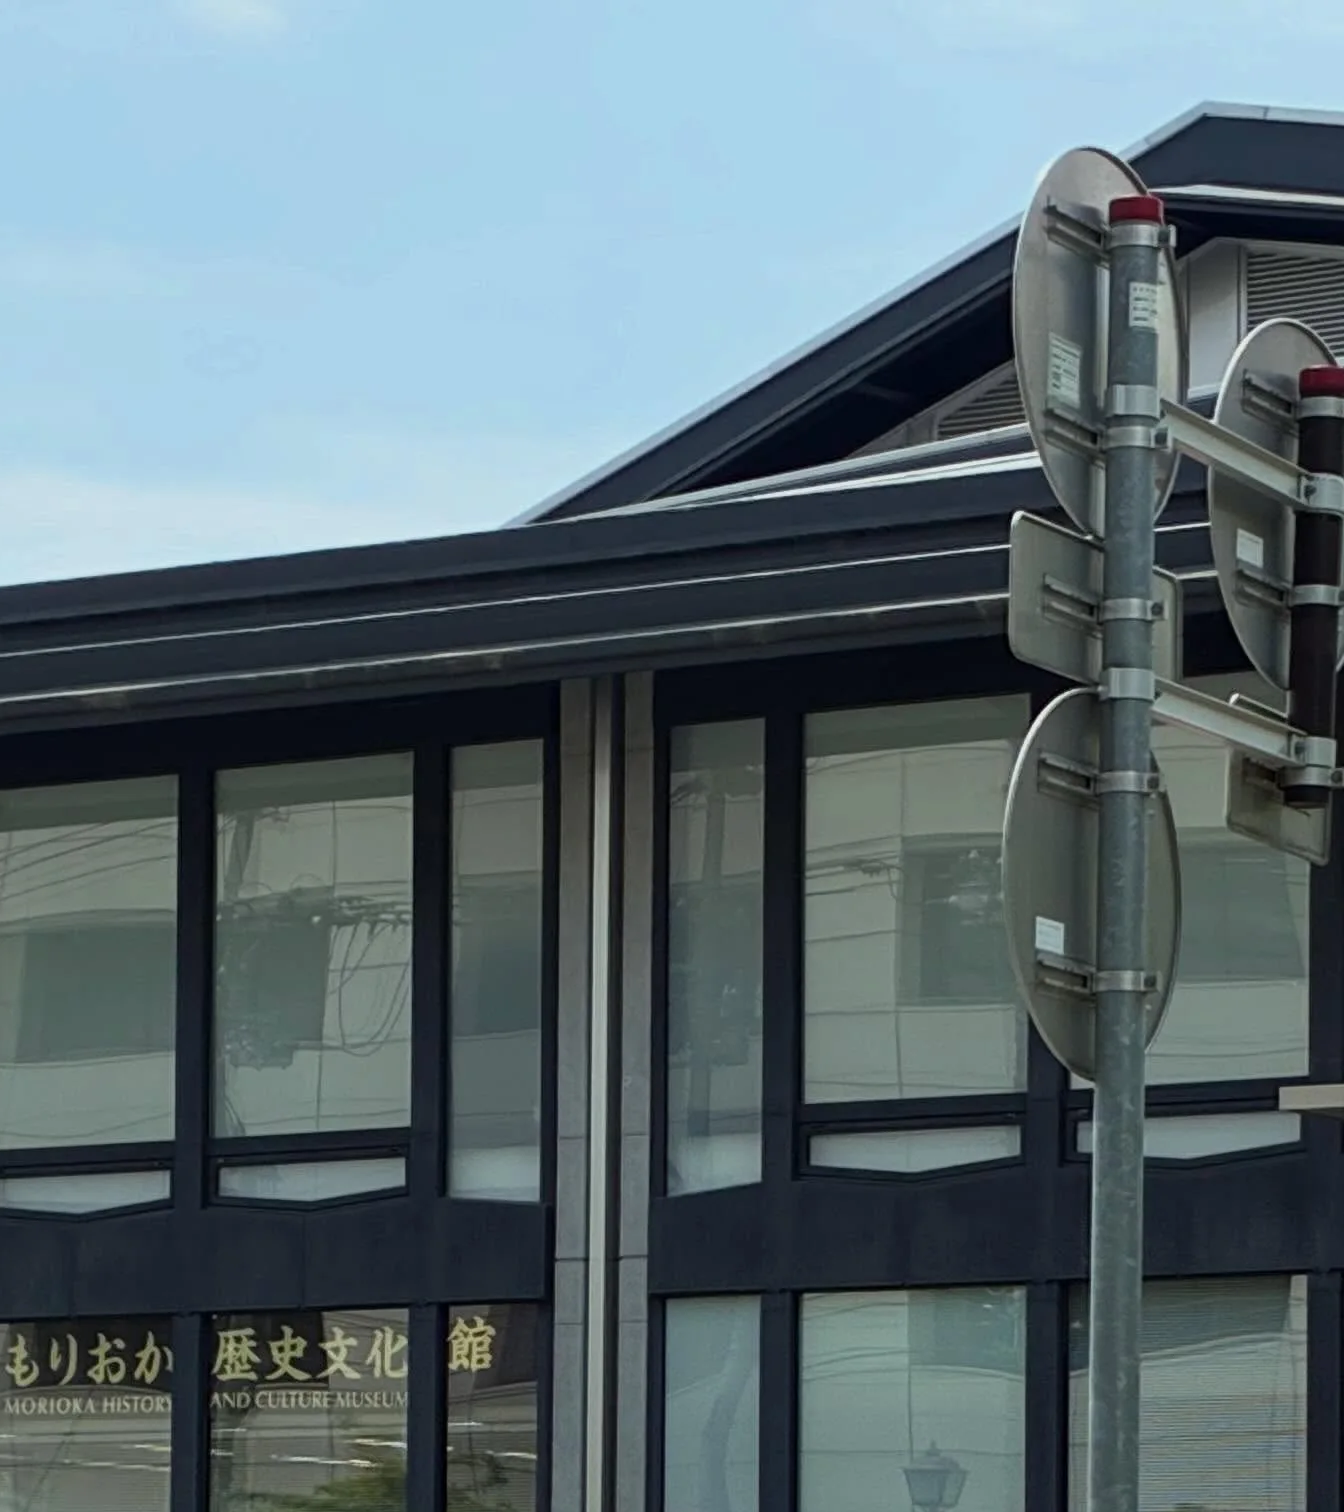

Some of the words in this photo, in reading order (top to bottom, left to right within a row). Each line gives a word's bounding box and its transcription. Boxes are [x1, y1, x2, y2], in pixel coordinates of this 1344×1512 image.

[5, 1331, 174, 1388] もりおか
[5, 1396, 96, 1416] MORIOKA
[102, 1394, 173, 1414] HISTORY
[210, 1391, 251, 1409] AND
[255, 1391, 334, 1409] CULTURE
[335, 1390, 408, 1409] MUSEUM
